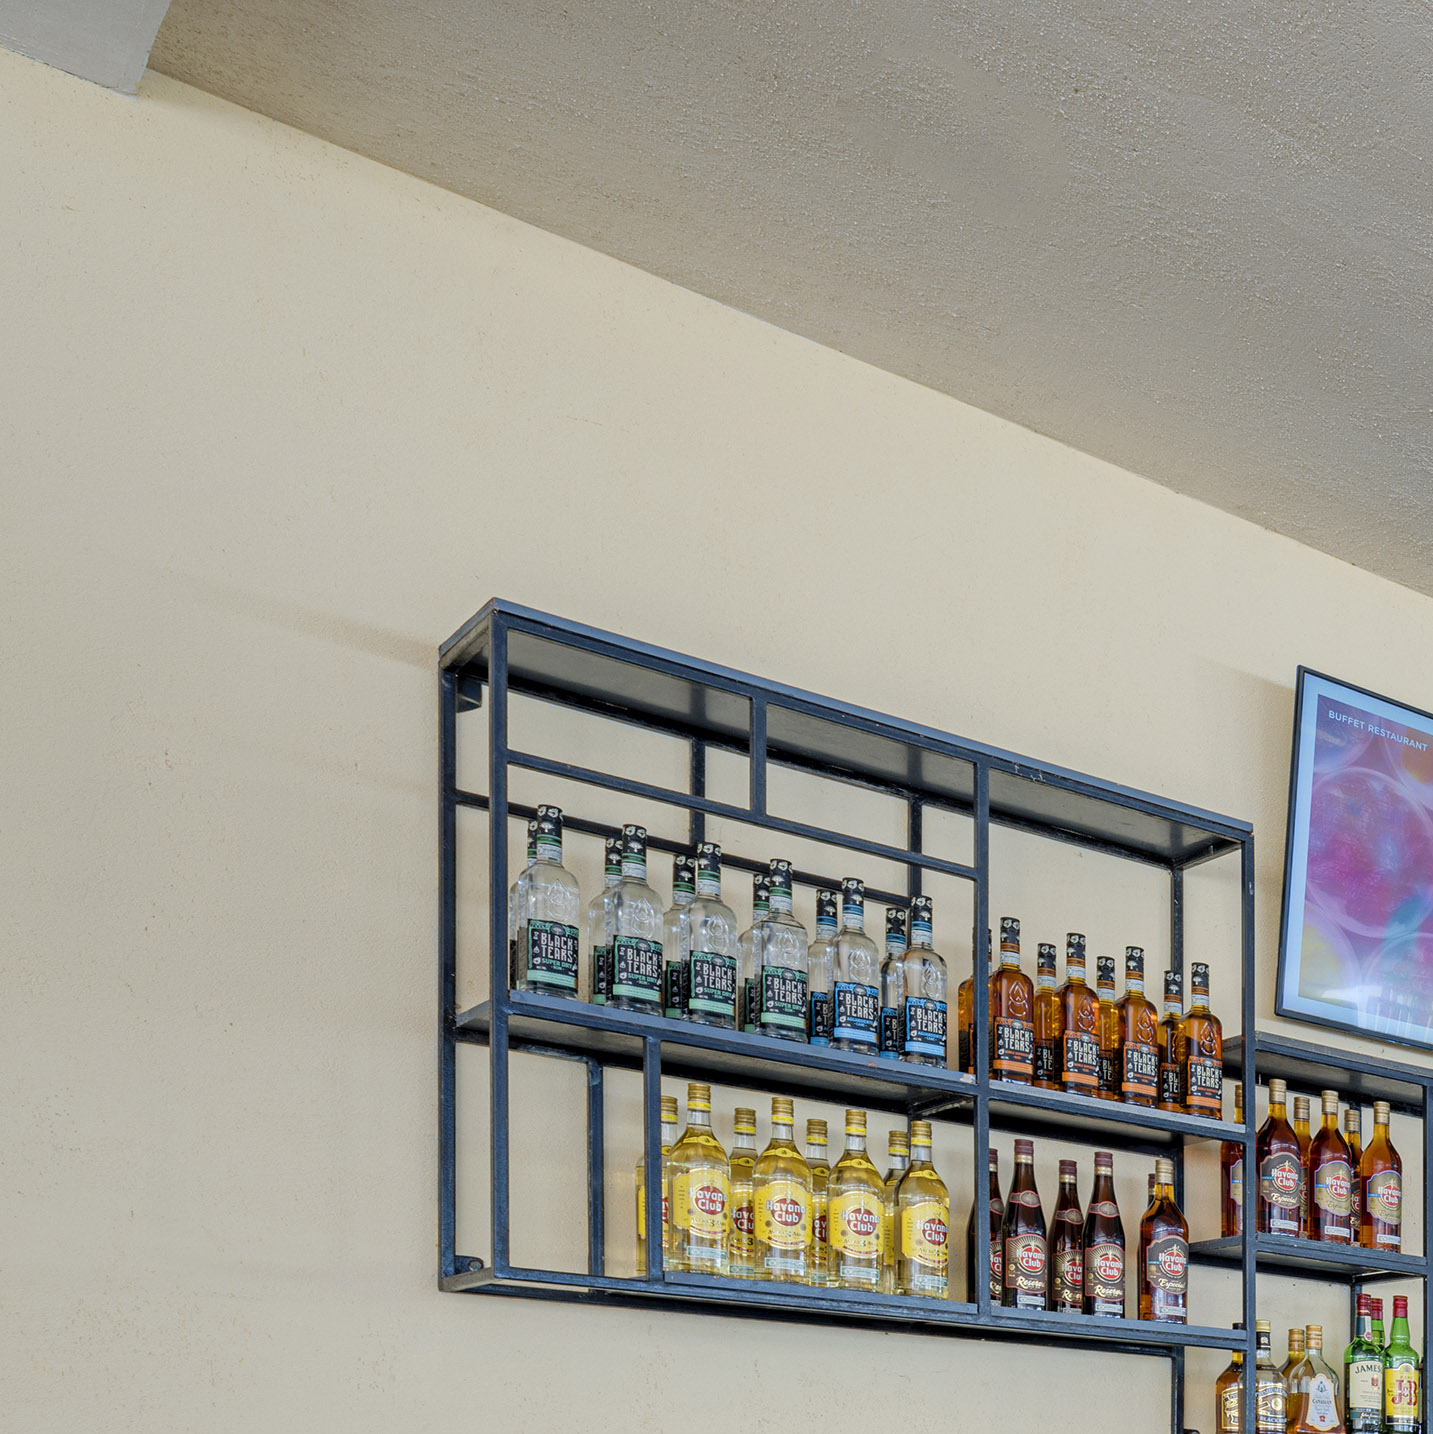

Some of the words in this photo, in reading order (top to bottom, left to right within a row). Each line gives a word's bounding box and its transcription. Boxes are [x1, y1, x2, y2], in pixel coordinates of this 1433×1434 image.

[1328, 710, 1366, 730] BUFFET
[1367, 724, 1428, 752] RESTAURANT
[540, 933, 574, 950] BLACK
[541, 946, 573, 963] TEARS
[627, 948, 658, 965] BLACK
[627, 961, 658, 977] TEARS
[703, 962, 733, 979] BLACK
[703, 975, 733, 992] TEARS
[773, 977, 803, 994] BLACK
[774, 989, 803, 1005] TEARS
[845, 994, 874, 1008] BLACK
[846, 1005, 874, 1020] TEARS
[916, 1007, 943, 1022] BLACK
[917, 1019, 943, 1035] TEARS
[1003, 1027, 1031, 1041] BLACK
[1004, 1037, 1031, 1052] TEARS
[1073, 1041, 1099, 1054] BLACK
[1073, 1051, 1098, 1065] TEARS
[1133, 1052, 1157, 1066] BLACK
[1133, 1061, 1157, 1076] TEARS
[1197, 1066, 1221, 1080] BLACK
[1197, 1075, 1221, 1090] TEARS
[1271, 1168, 1299, 1180] Havana
[1277, 1177, 1295, 1187] Club
[1326, 1176, 1350, 1188] Havana
[689, 1185, 728, 1202] Havana
[1332, 1185, 1347, 1196] Club
[1377, 1186, 1401, 1198] Havana
[697, 1199, 723, 1212] Club
[1383, 1194, 1399, 1204] Club
[766, 1200, 806, 1215] Havana
[774, 1211, 800, 1223] Club
[841, 1209, 880, 1225] Havana
[850, 1220, 874, 1233] Club
[925, 1230, 945, 1243] Club
[1016, 1250, 1046, 1261] Havana
[1158, 1253, 1188, 1264] Havana
[1022, 1258, 1042, 1269] Club
[1095, 1258, 1124, 1270] Havana
[1165, 1261, 1183, 1272] Club
[1100, 1267, 1119, 1276] Club
[1158, 1278, 1187, 1290] Especial
